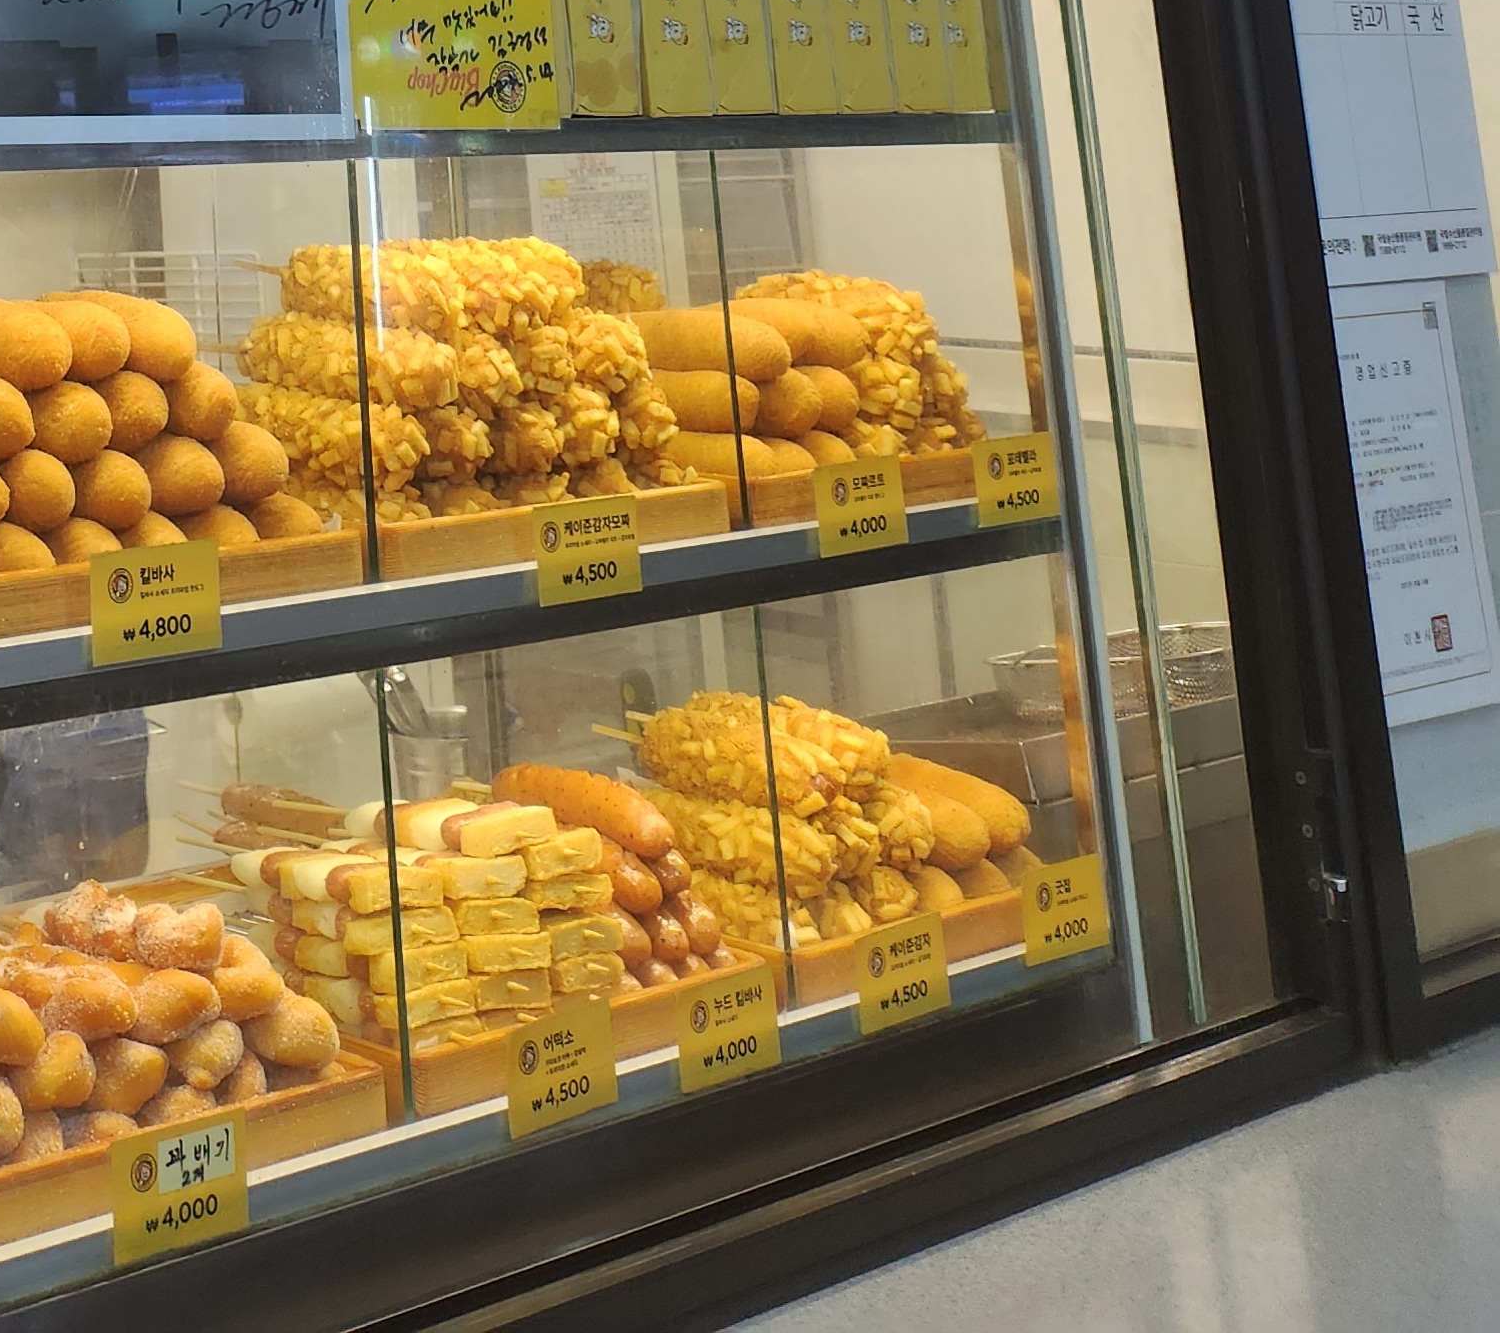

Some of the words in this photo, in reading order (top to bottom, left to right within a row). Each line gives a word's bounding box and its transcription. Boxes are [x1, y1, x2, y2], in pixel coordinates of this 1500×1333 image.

[1350, 5, 1389, 31] 닭고기
[140, 563, 175, 585] 킬바사
[714, 994, 733, 1014] 누드
